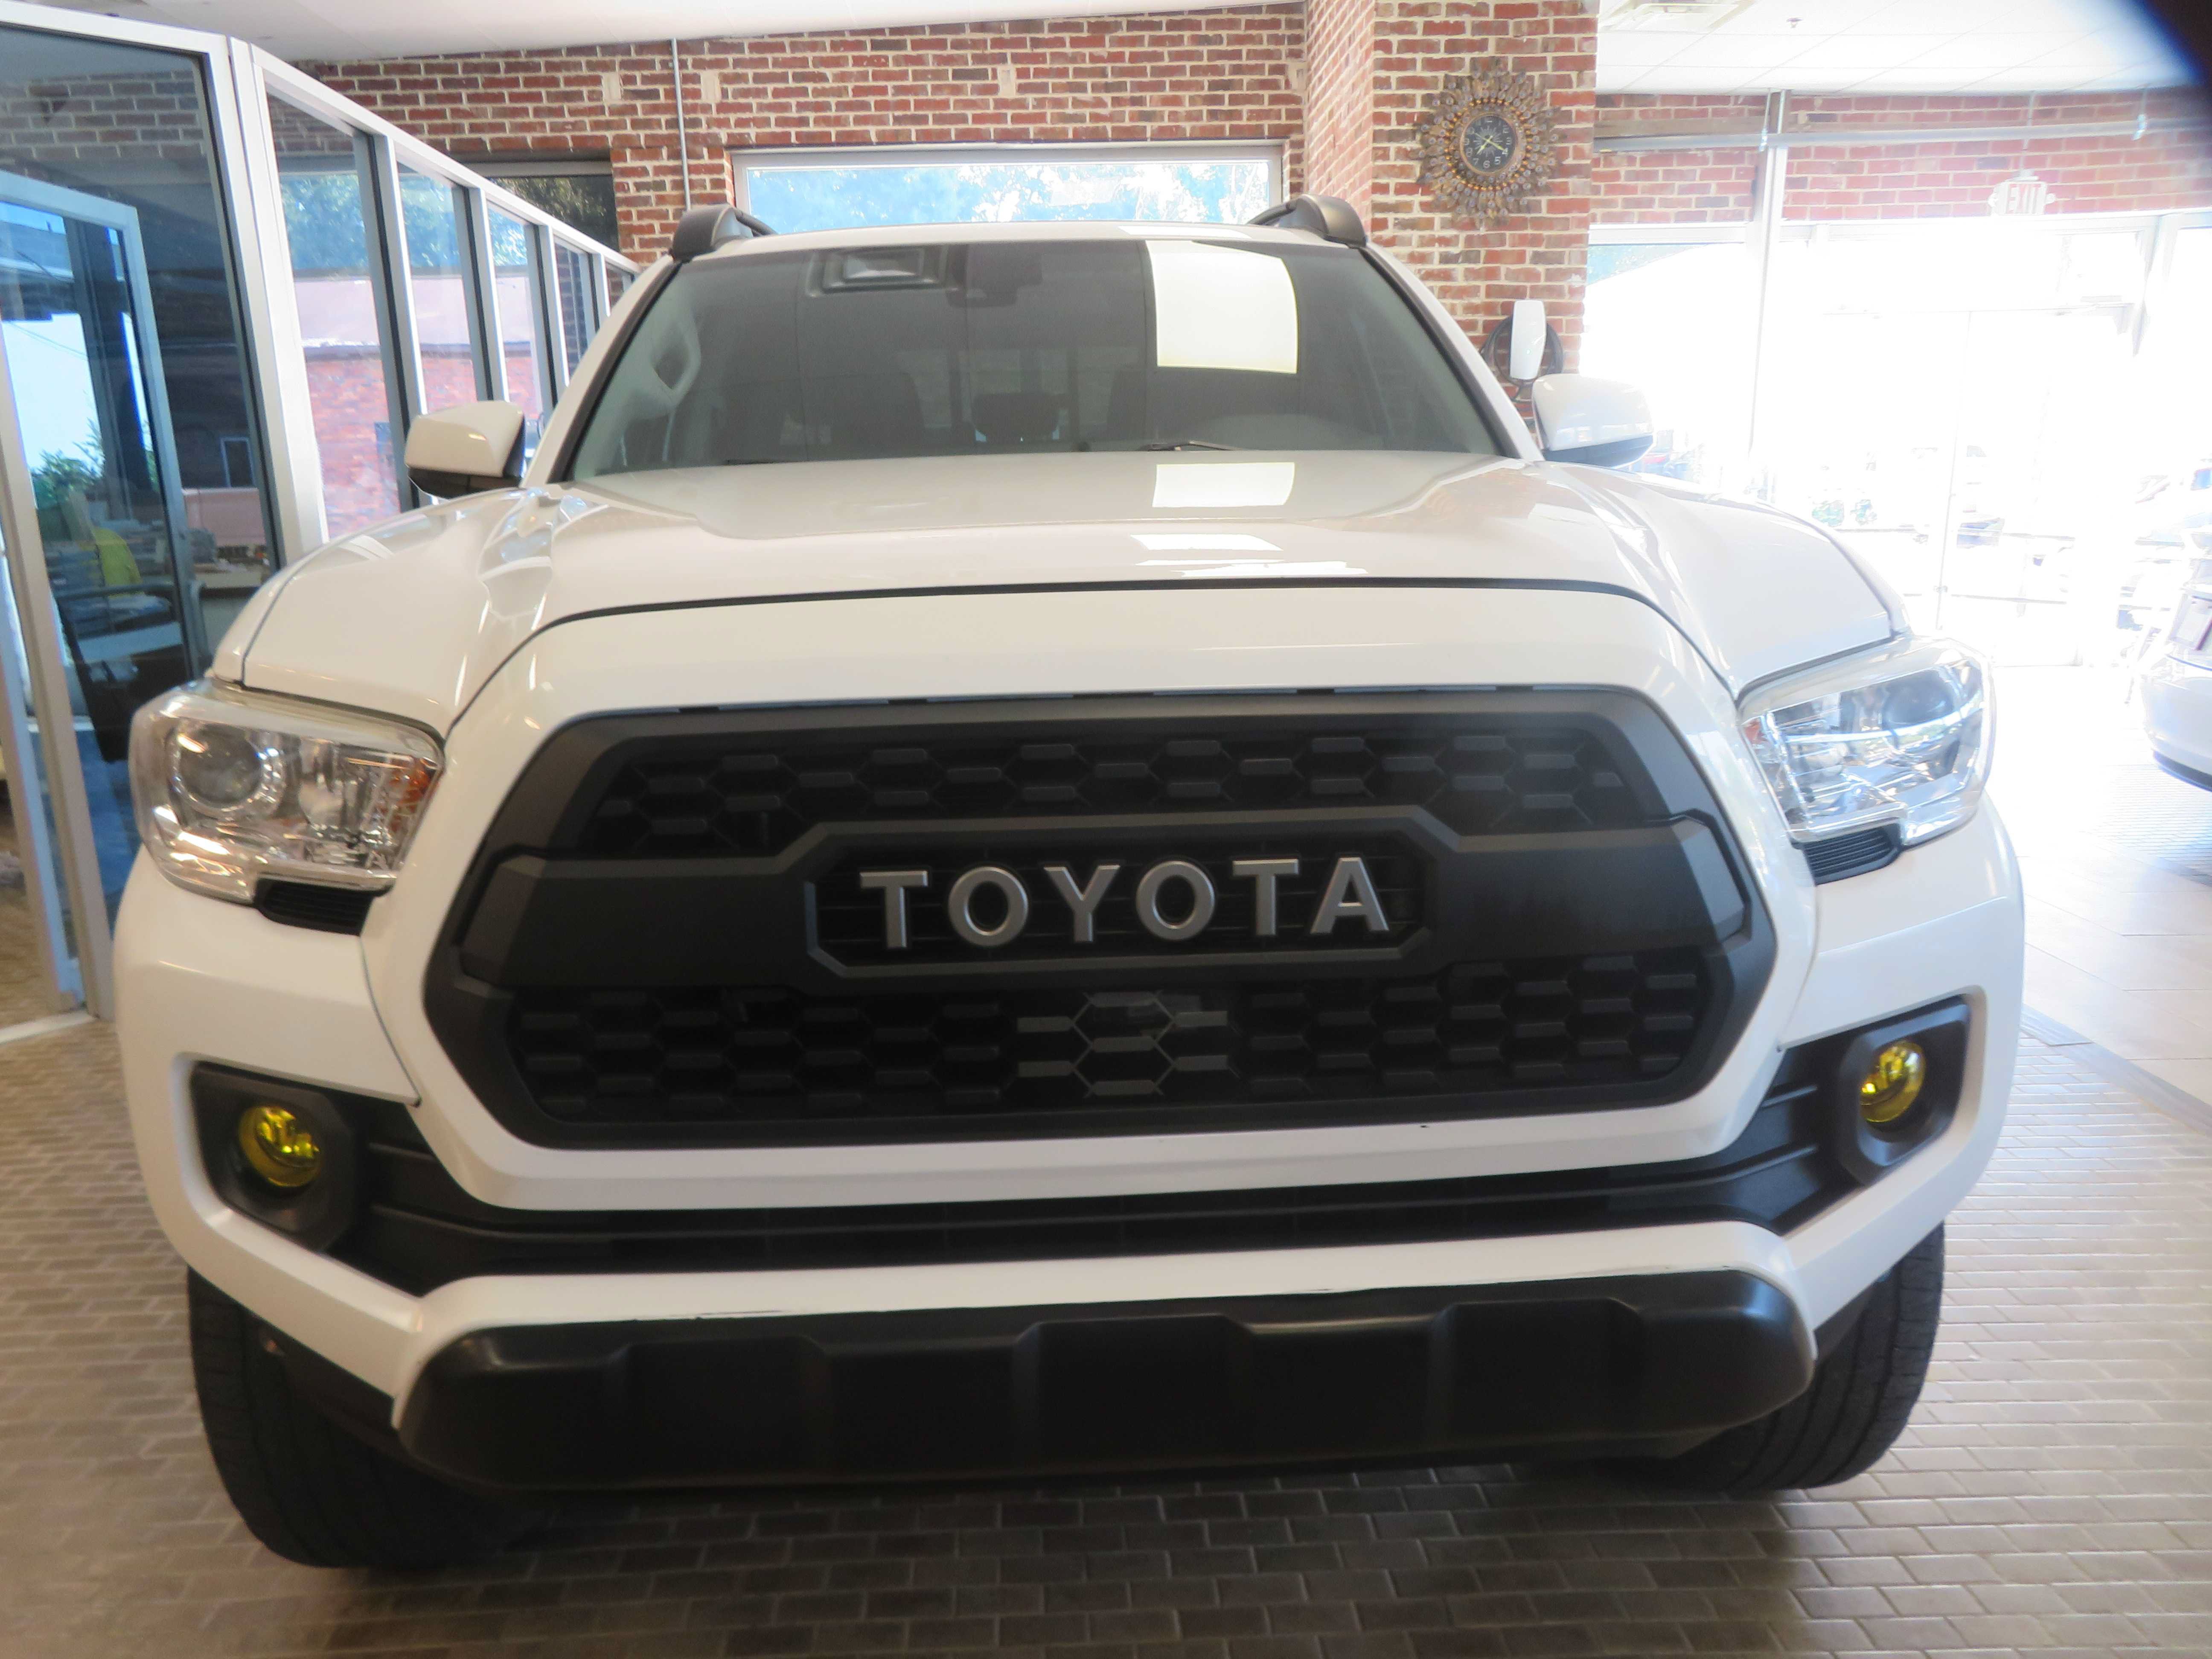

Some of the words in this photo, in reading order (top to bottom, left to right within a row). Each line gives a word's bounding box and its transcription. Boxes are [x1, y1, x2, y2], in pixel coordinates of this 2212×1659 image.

[1502, 148, 1508, 157] 4
[1483, 160, 1490, 168] 6
[1494, 157, 1501, 165] 5
[2006, 184, 2041, 213] EXIT
[859, 857, 1390, 948] TOYOTA
